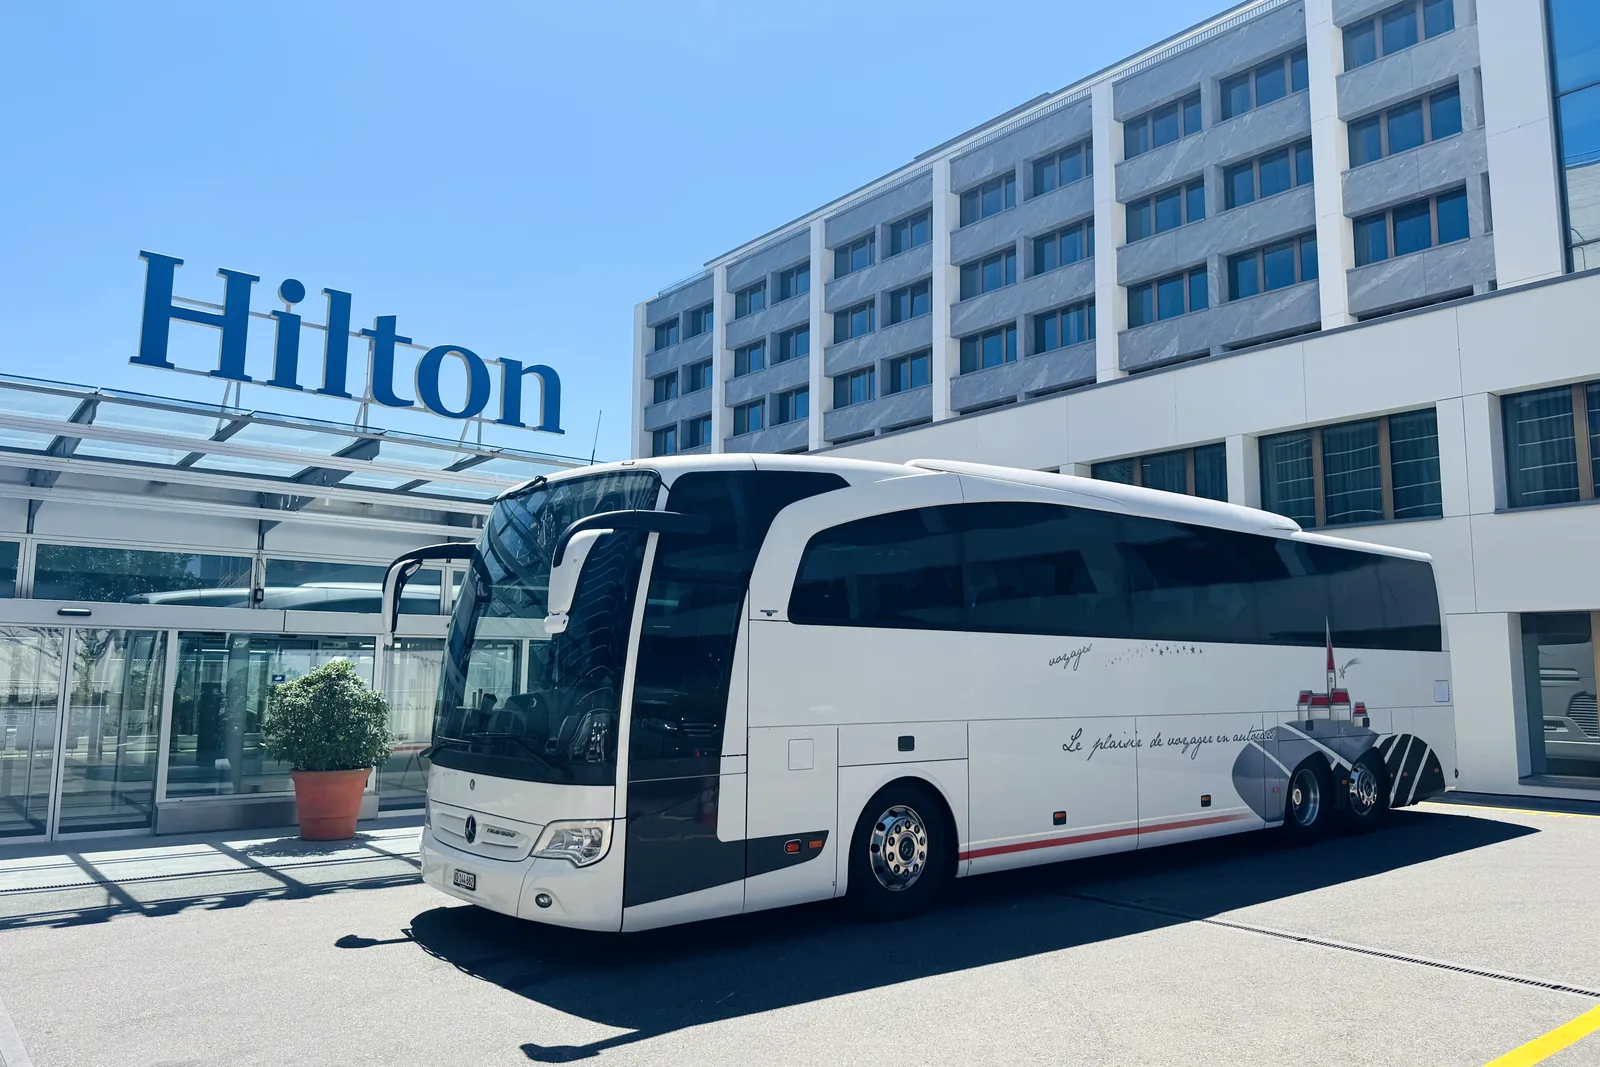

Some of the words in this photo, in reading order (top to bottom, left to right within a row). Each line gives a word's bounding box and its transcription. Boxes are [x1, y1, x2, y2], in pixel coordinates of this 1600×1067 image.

[128, 250, 565, 435] Hilton
[1048, 643, 1093, 671] voyages
[1062, 727, 1083, 752] Le
[1087, 731, 1143, 761] plaisir
[1149, 731, 1164, 748] de
[1167, 735, 1214, 760] voyager
[1216, 735, 1231, 744] en
[1232, 725, 1276, 743] autocars
